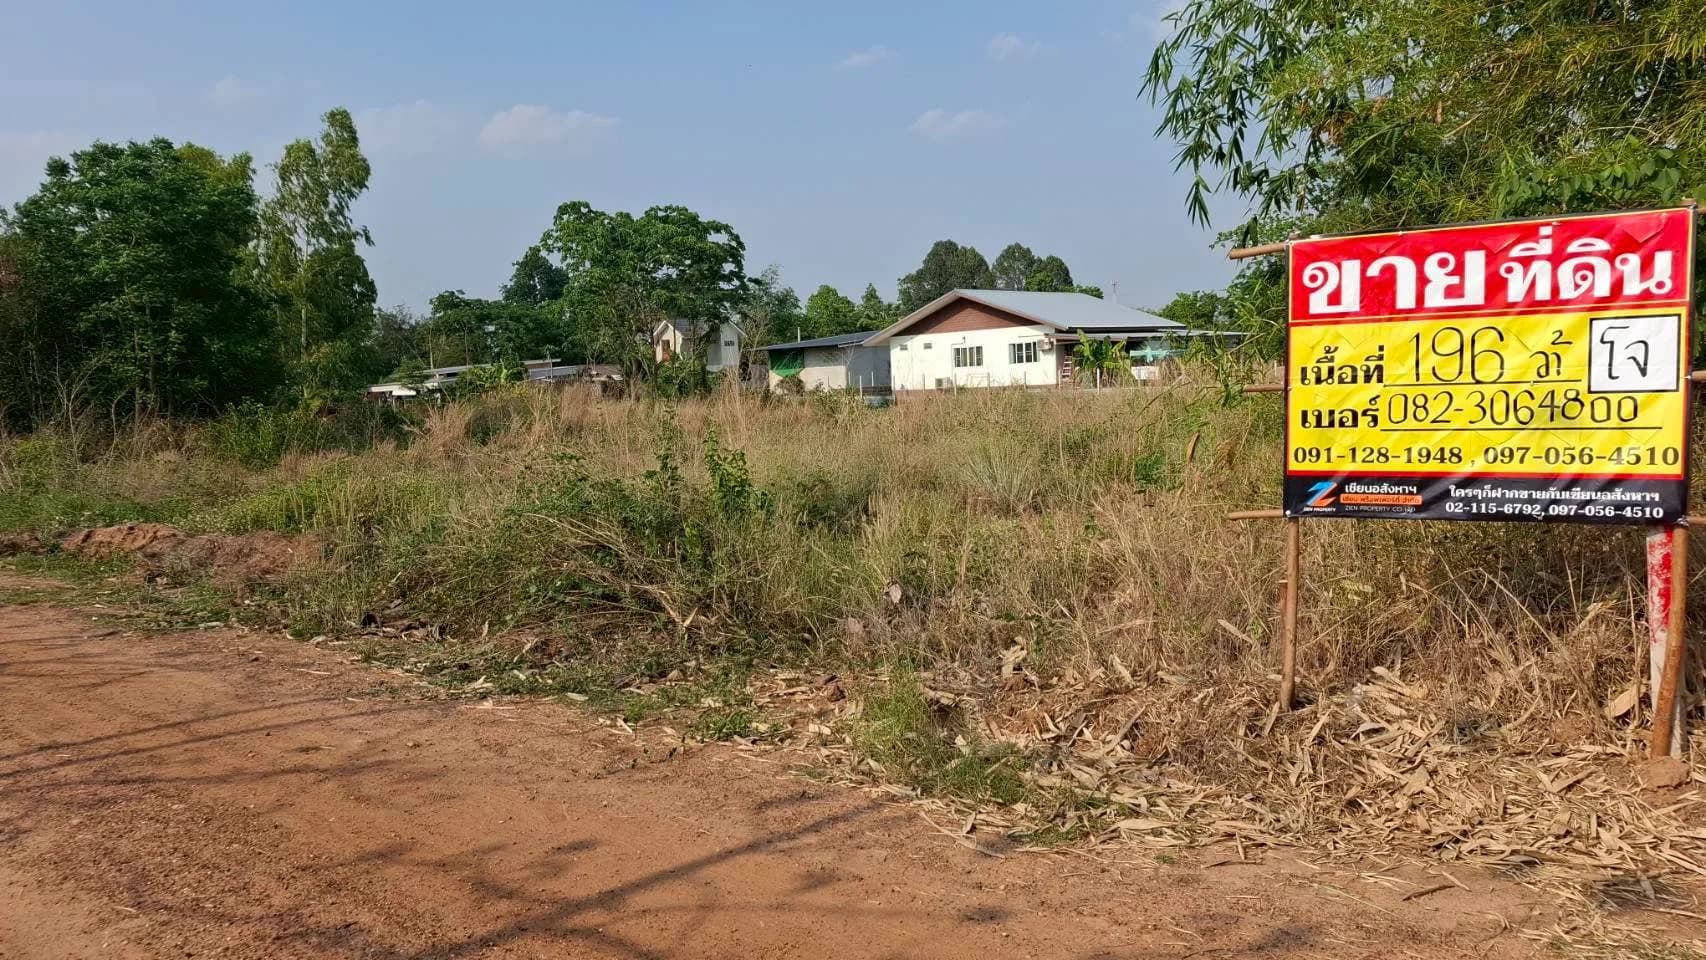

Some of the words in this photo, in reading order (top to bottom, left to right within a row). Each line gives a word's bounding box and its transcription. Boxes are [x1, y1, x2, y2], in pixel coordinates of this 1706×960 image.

[1302, 249, 1486, 315] ขาย
[1499, 226, 1673, 302] ที่ดิน
[1300, 345, 1385, 386] เนื้อที่
[1408, 326, 1504, 383] 196
[1301, 394, 1381, 429] เบอร์
[1387, 389, 1639, 426] 082-3064800
[1293, 446, 1464, 464] 091-128-1948
[1483, 446, 1680, 466] 097-056-4510
[1549, 503, 1664, 519] 097-056-4510
